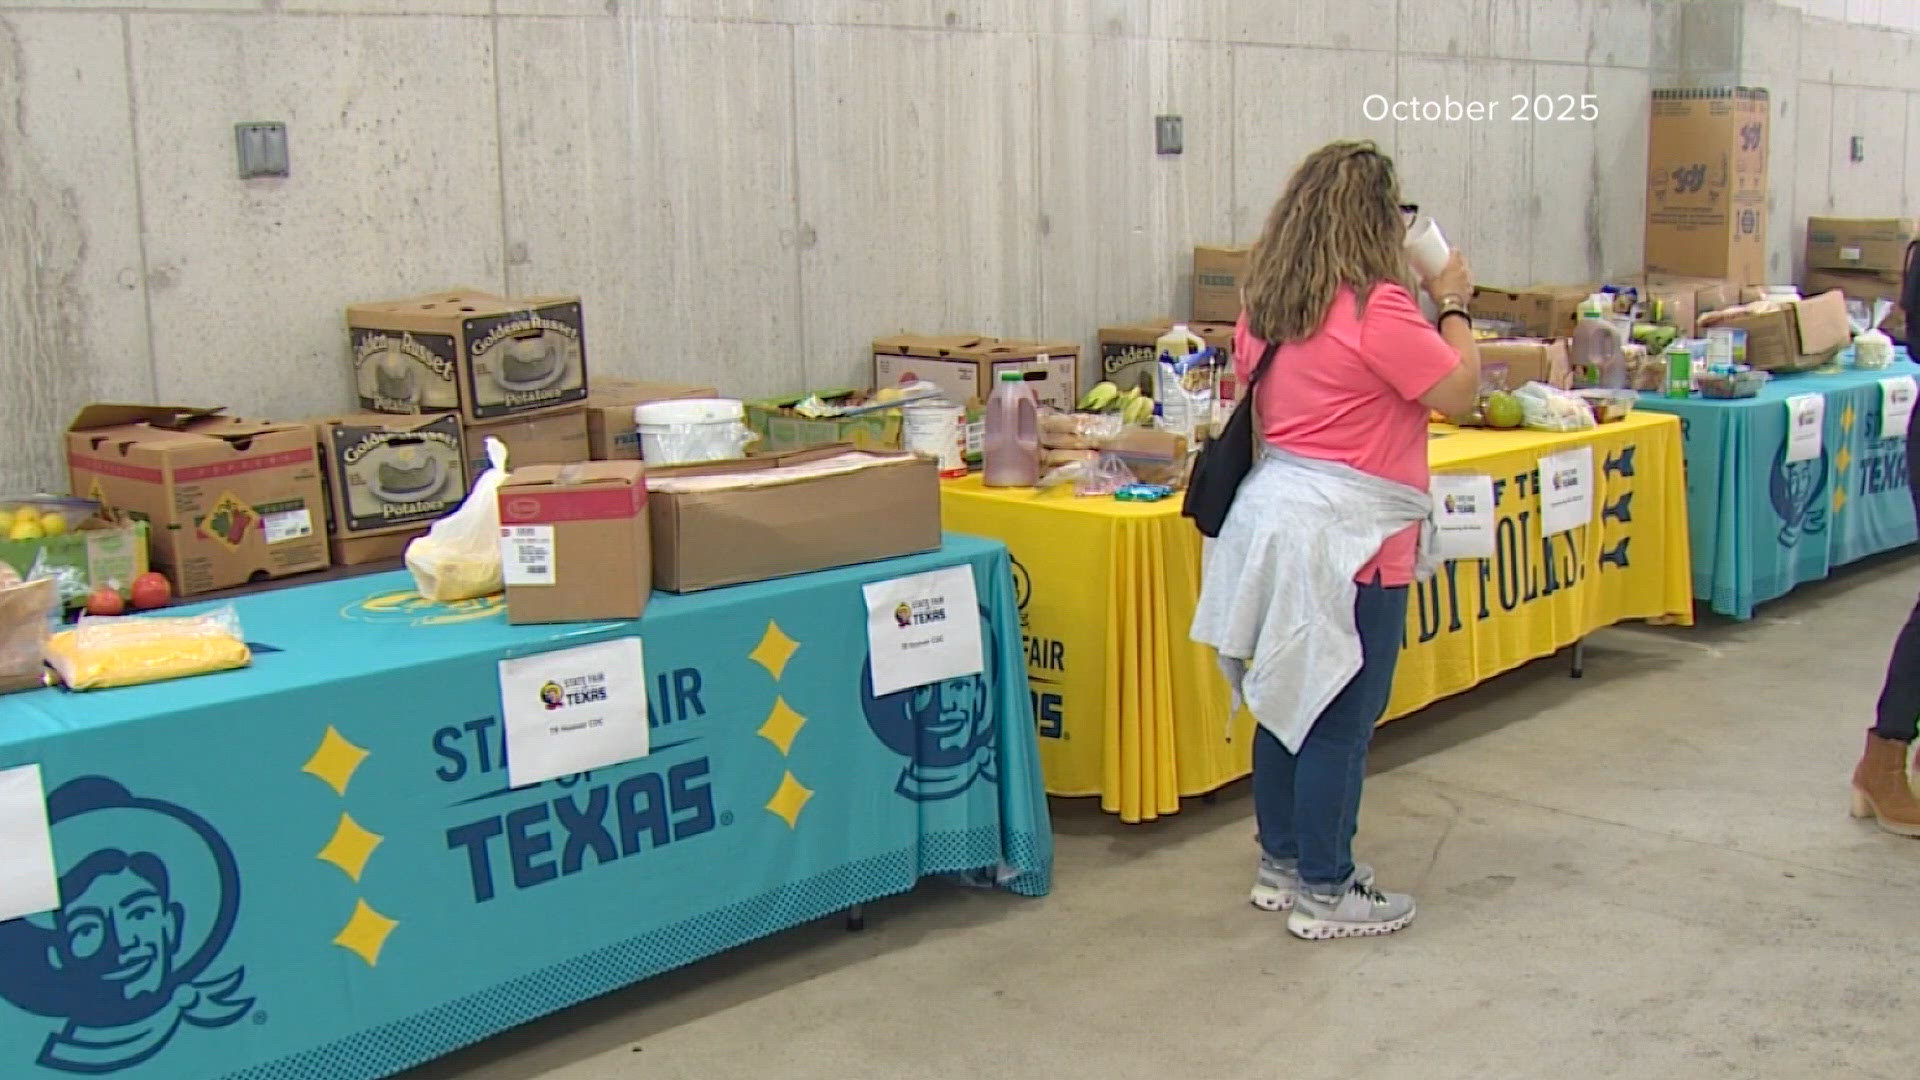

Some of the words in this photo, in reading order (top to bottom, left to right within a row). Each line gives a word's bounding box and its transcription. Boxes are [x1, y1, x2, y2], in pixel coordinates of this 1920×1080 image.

[1105, 348, 1155, 375] Golden
[1859, 452, 1908, 497] TEXA
[565, 687, 608, 706] TEXAS
[446, 755, 716, 904] TEXAS
